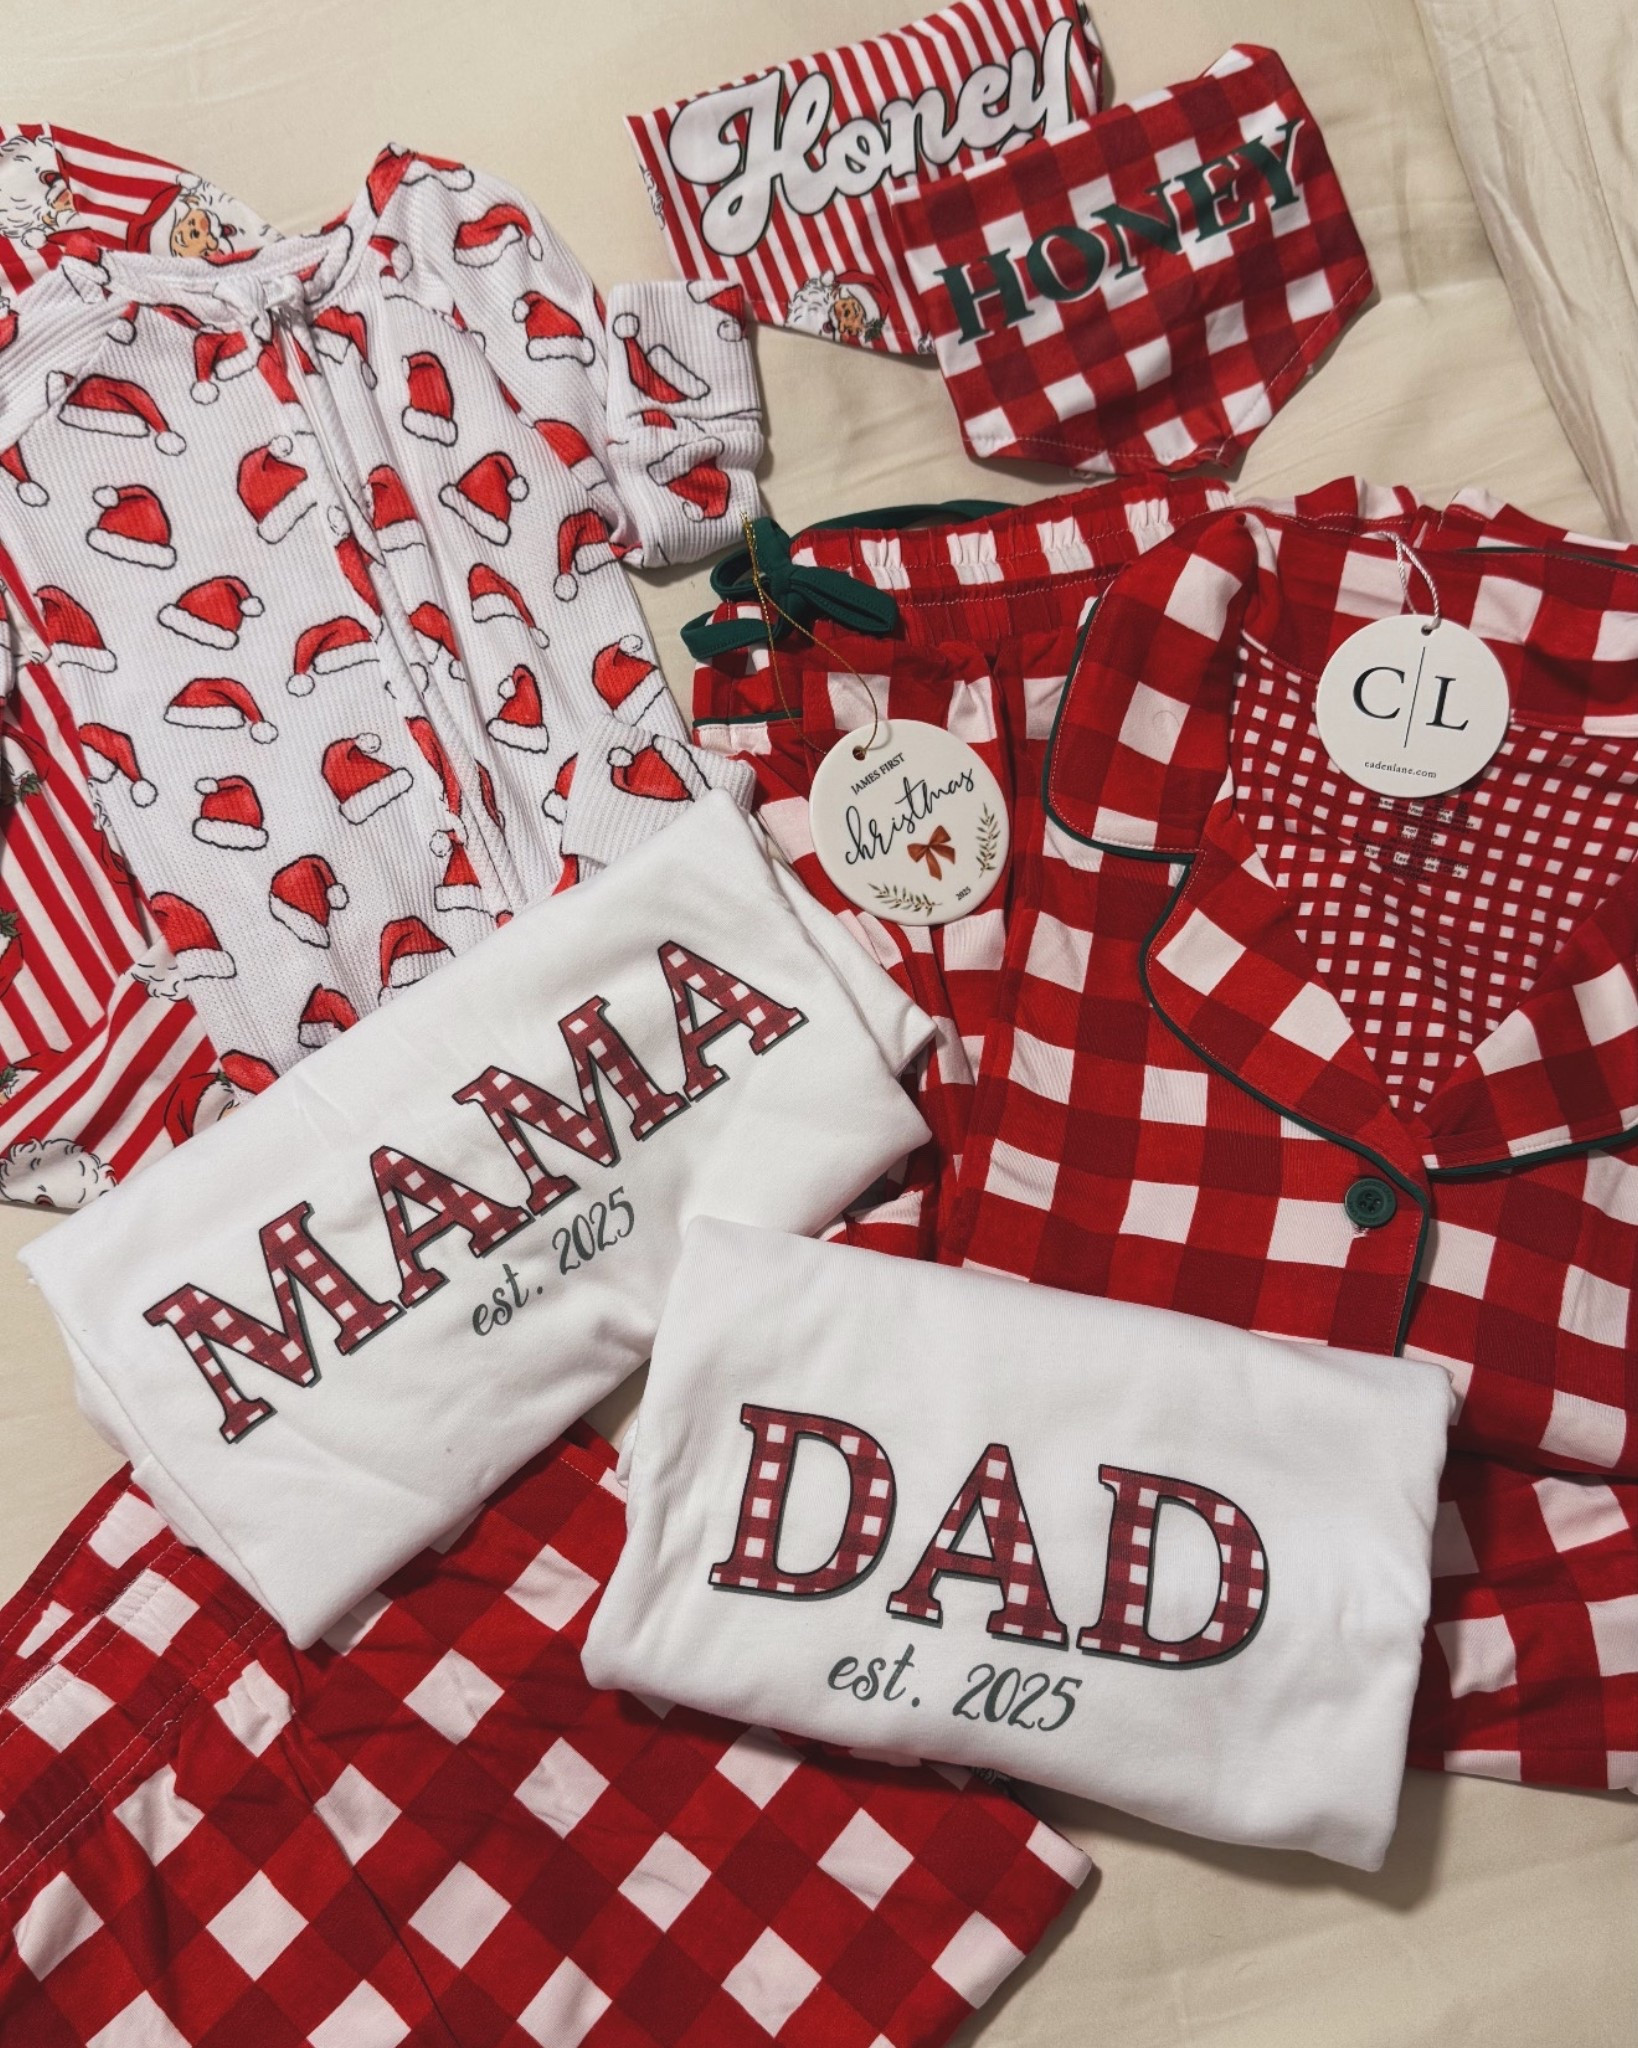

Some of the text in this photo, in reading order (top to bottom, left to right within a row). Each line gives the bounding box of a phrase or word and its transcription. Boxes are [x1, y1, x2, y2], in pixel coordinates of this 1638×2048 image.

[668, 17, 1074, 257] Honey
[933, 118, 1306, 346] HONEY
[852, 752, 905, 795] JAMES FIRST
[1363, 759, 1438, 780] cadenlane.com
[142, 939, 810, 1445] MAMA
[471, 1186, 637, 1338] est. 2025
[707, 1402, 1271, 1672] DAD
[827, 1642, 1084, 1733] est. 2025
